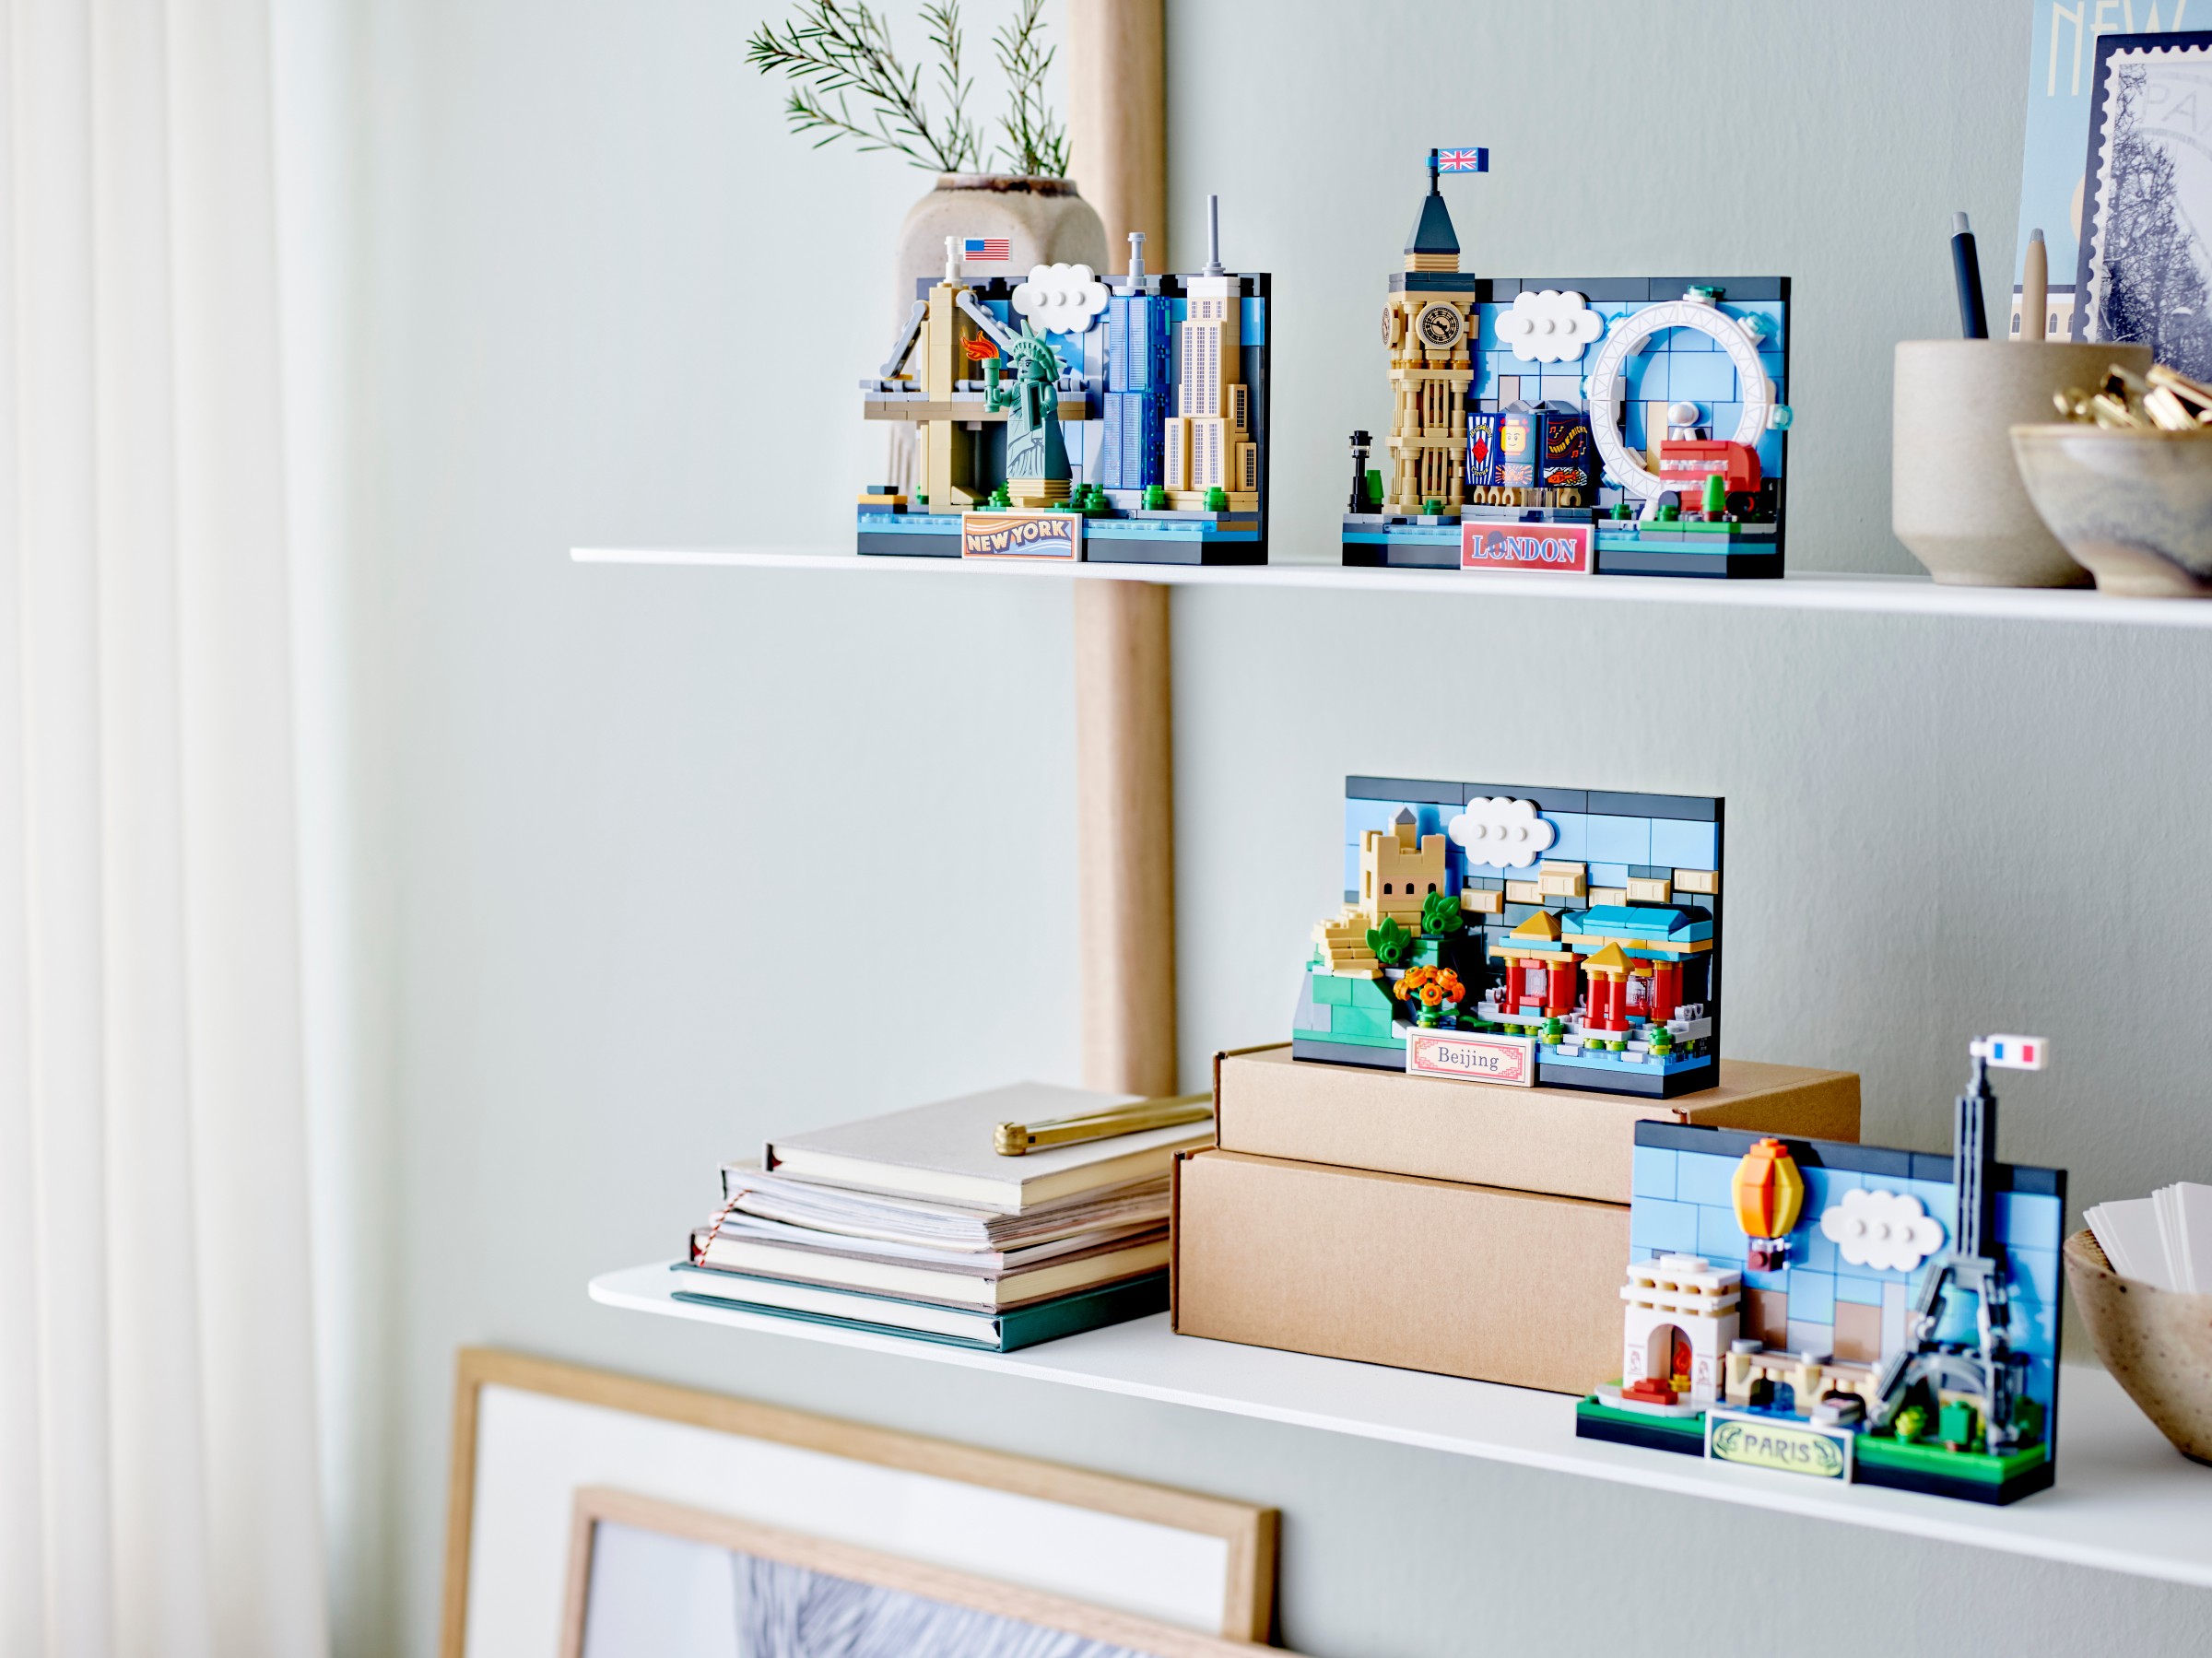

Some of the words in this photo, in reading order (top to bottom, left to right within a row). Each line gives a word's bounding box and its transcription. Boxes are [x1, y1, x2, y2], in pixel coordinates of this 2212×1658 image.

[2141, 82, 2212, 136] PA
[967, 531, 1010, 553] NEW
[1011, 520, 1067, 545] YORK
[1472, 534, 1578, 563] LONDON
[1438, 1046, 1500, 1071] Beijing
[1744, 1434, 1811, 1464] PARIS
